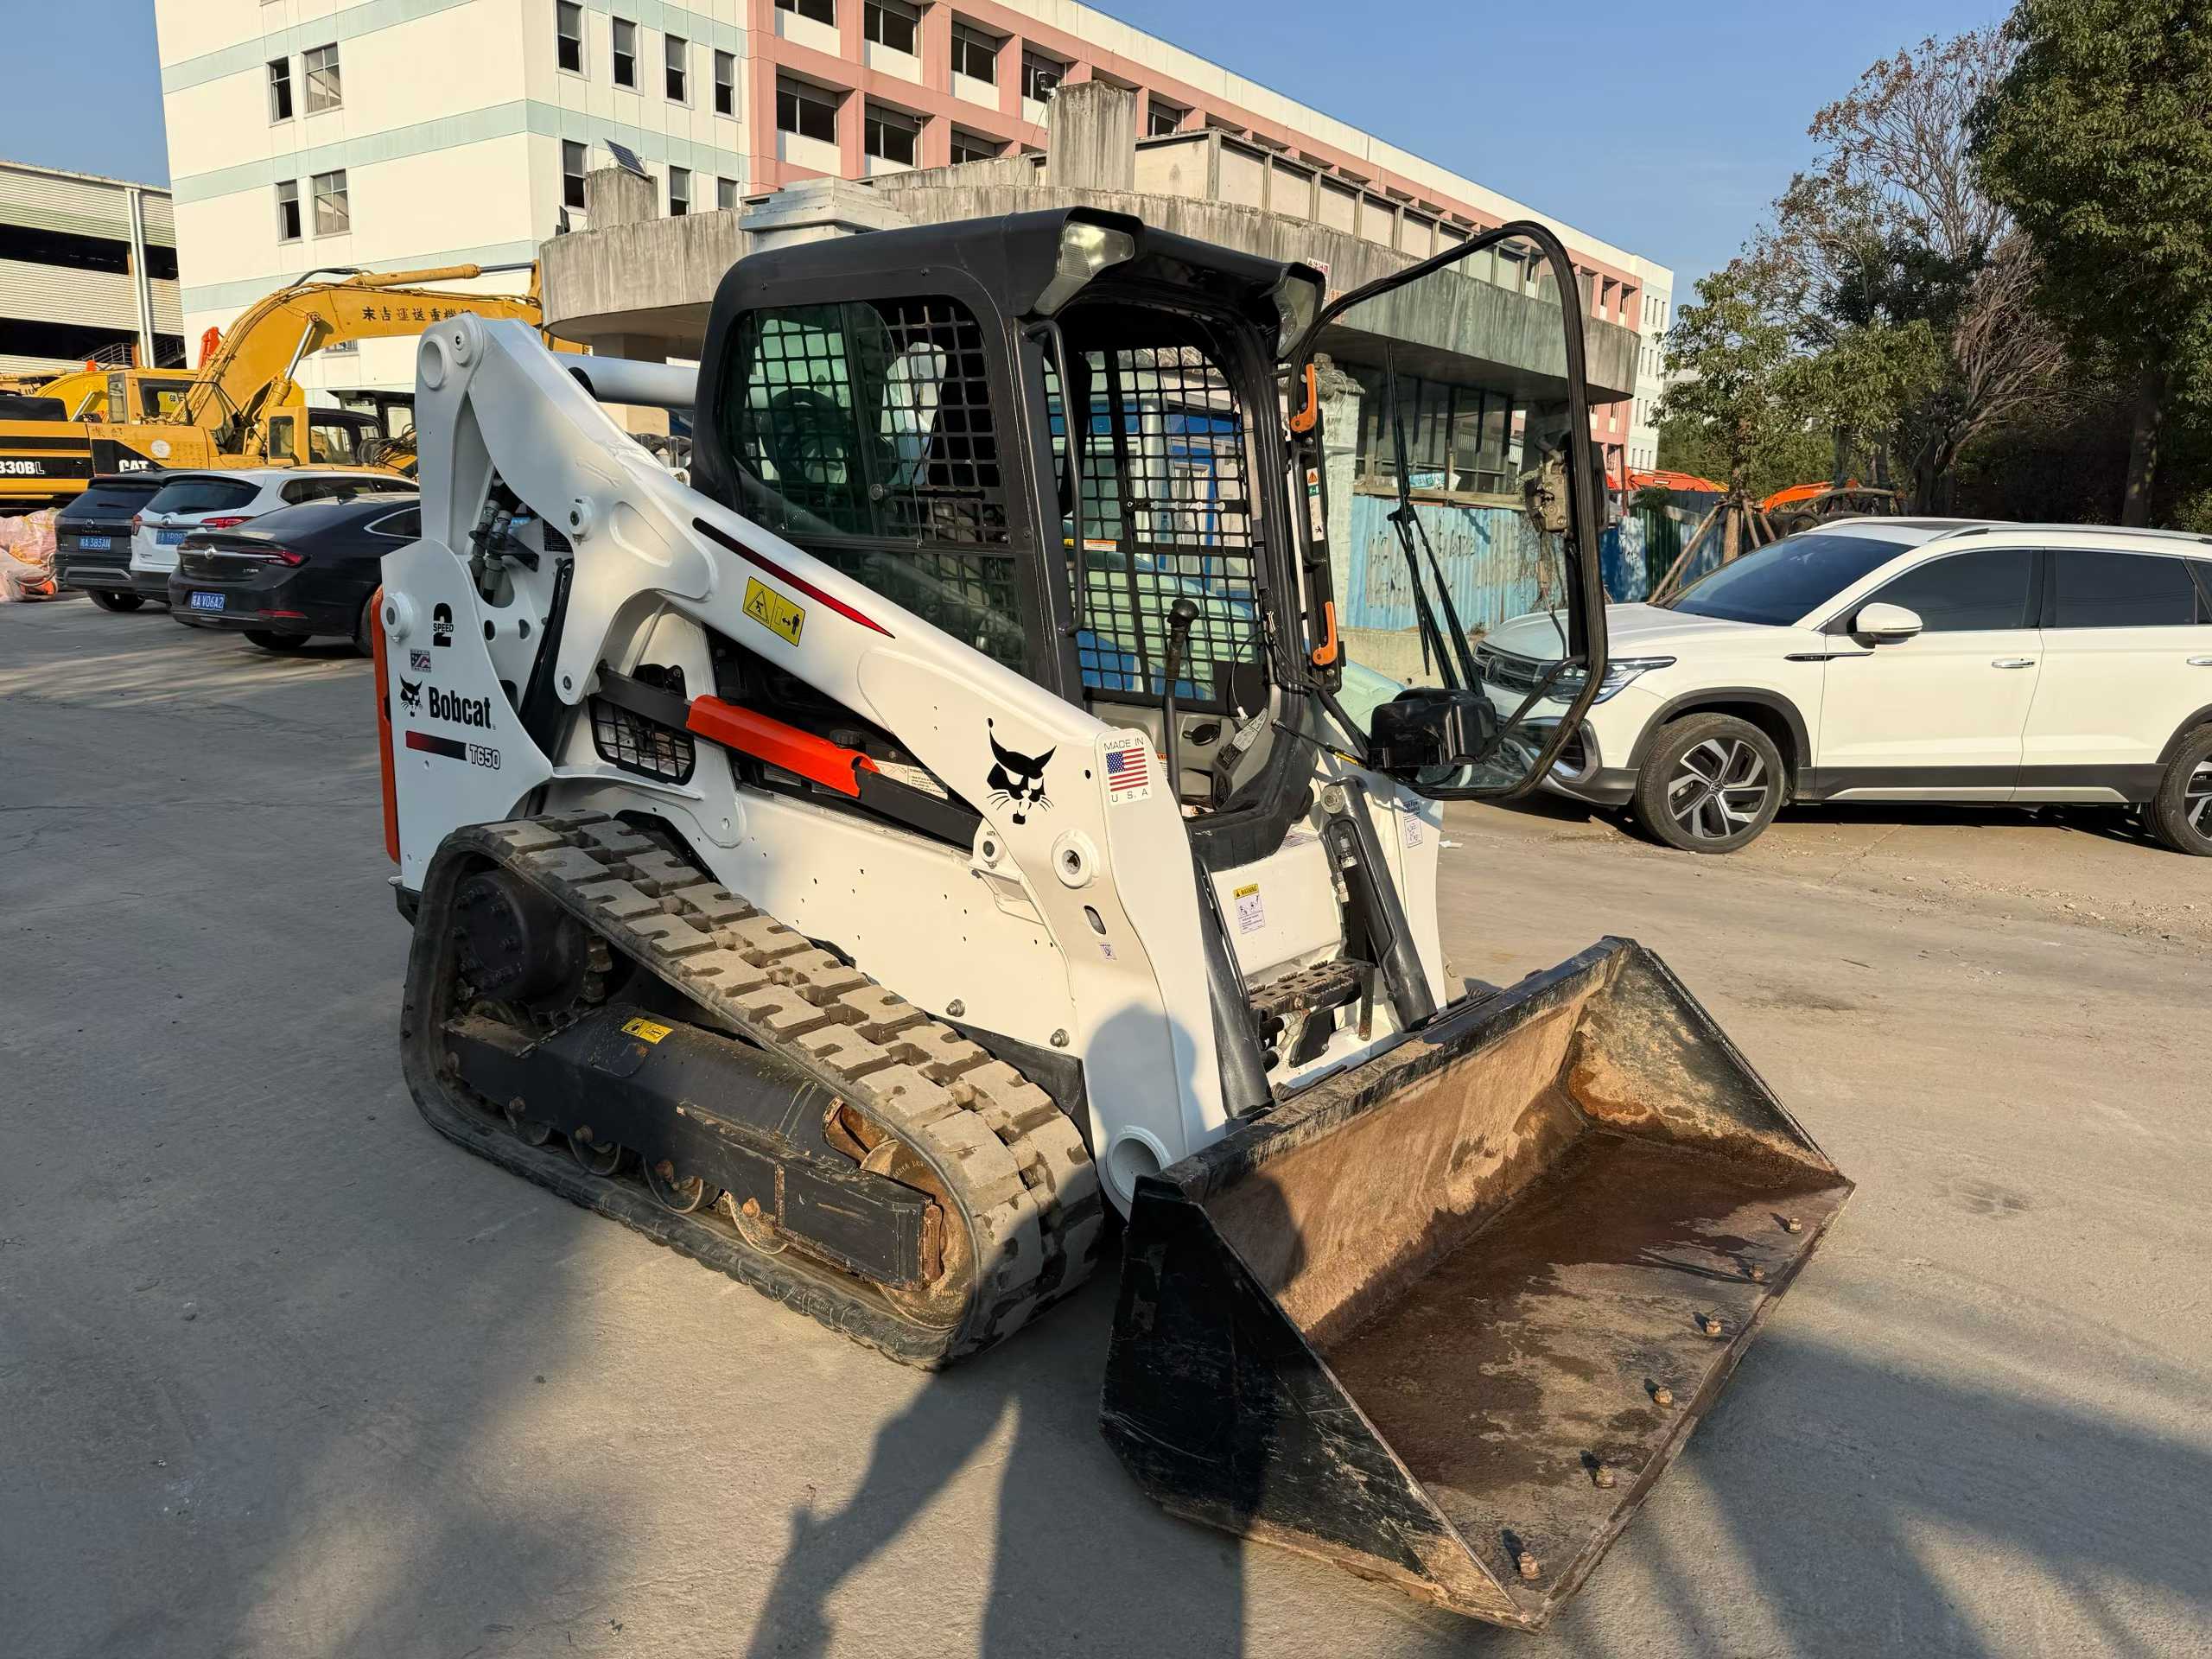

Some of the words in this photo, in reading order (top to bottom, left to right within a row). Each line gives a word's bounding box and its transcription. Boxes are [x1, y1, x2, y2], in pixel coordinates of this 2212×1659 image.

[119, 460, 149, 472] CAT
[433, 603, 452, 647] 2
[433, 622, 454, 632] SPEED
[428, 686, 491, 728] Bobcat
[1104, 739, 1131, 751] MADE
[1135, 737, 1144, 746] IN
[469, 744, 501, 770] T650
